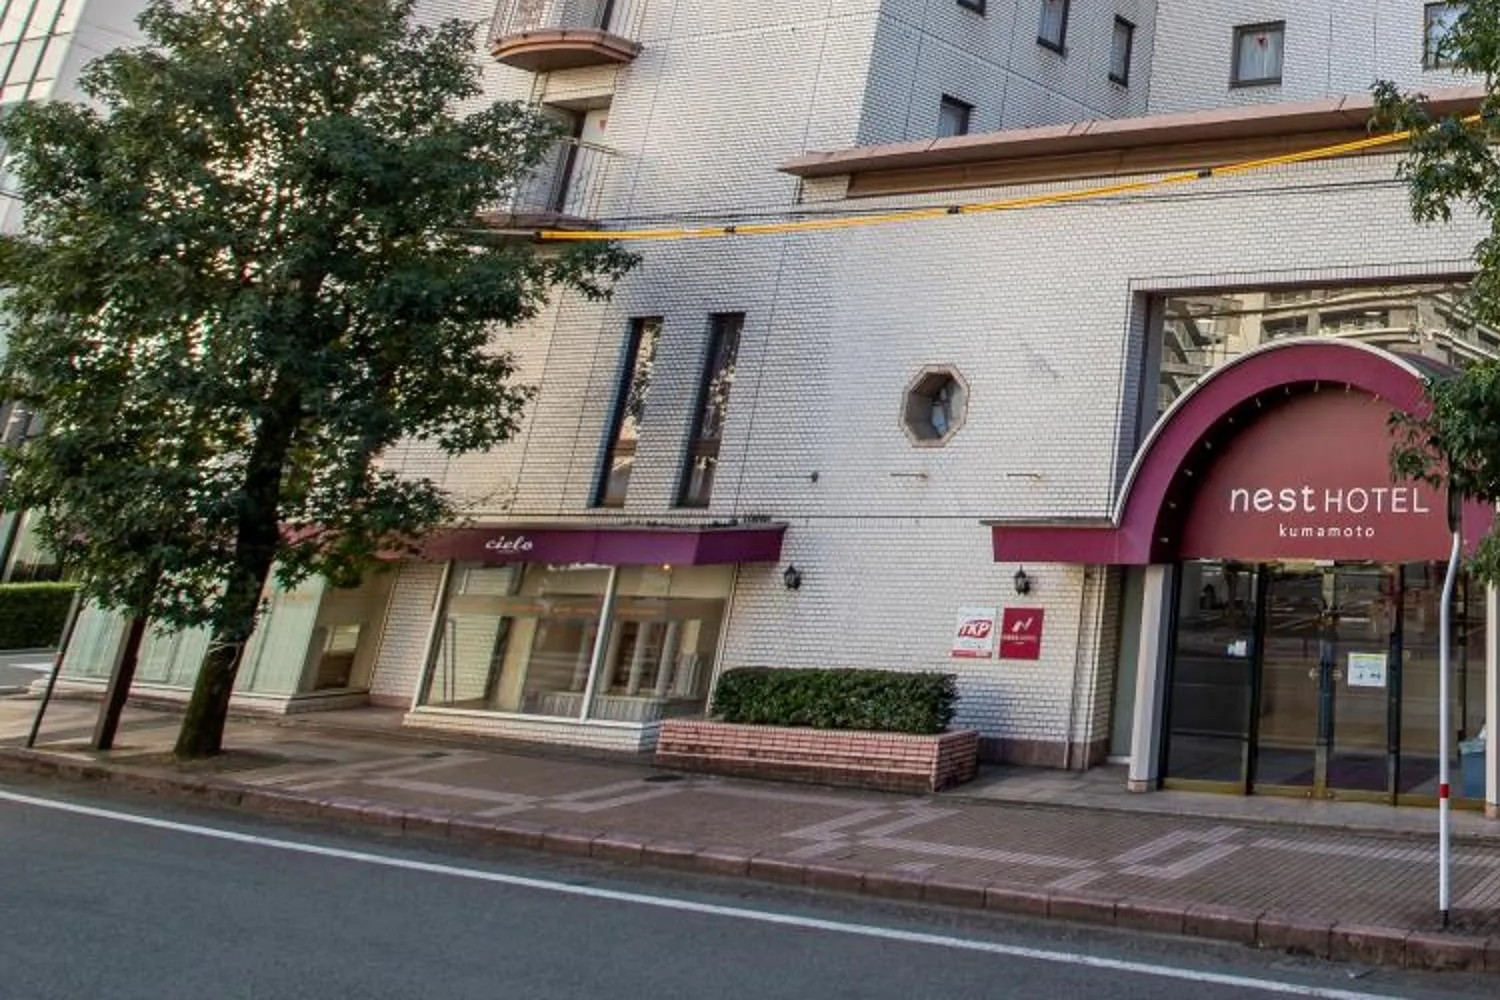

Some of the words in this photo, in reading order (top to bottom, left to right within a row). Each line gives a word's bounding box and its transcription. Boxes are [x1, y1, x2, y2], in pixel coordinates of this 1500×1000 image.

[1229, 485, 1316, 513] nest
[1324, 487, 1430, 513] HOTEL
[1279, 523, 1376, 537] kumamoto
[485, 535, 533, 551] cielo
[959, 622, 991, 637] TKP
